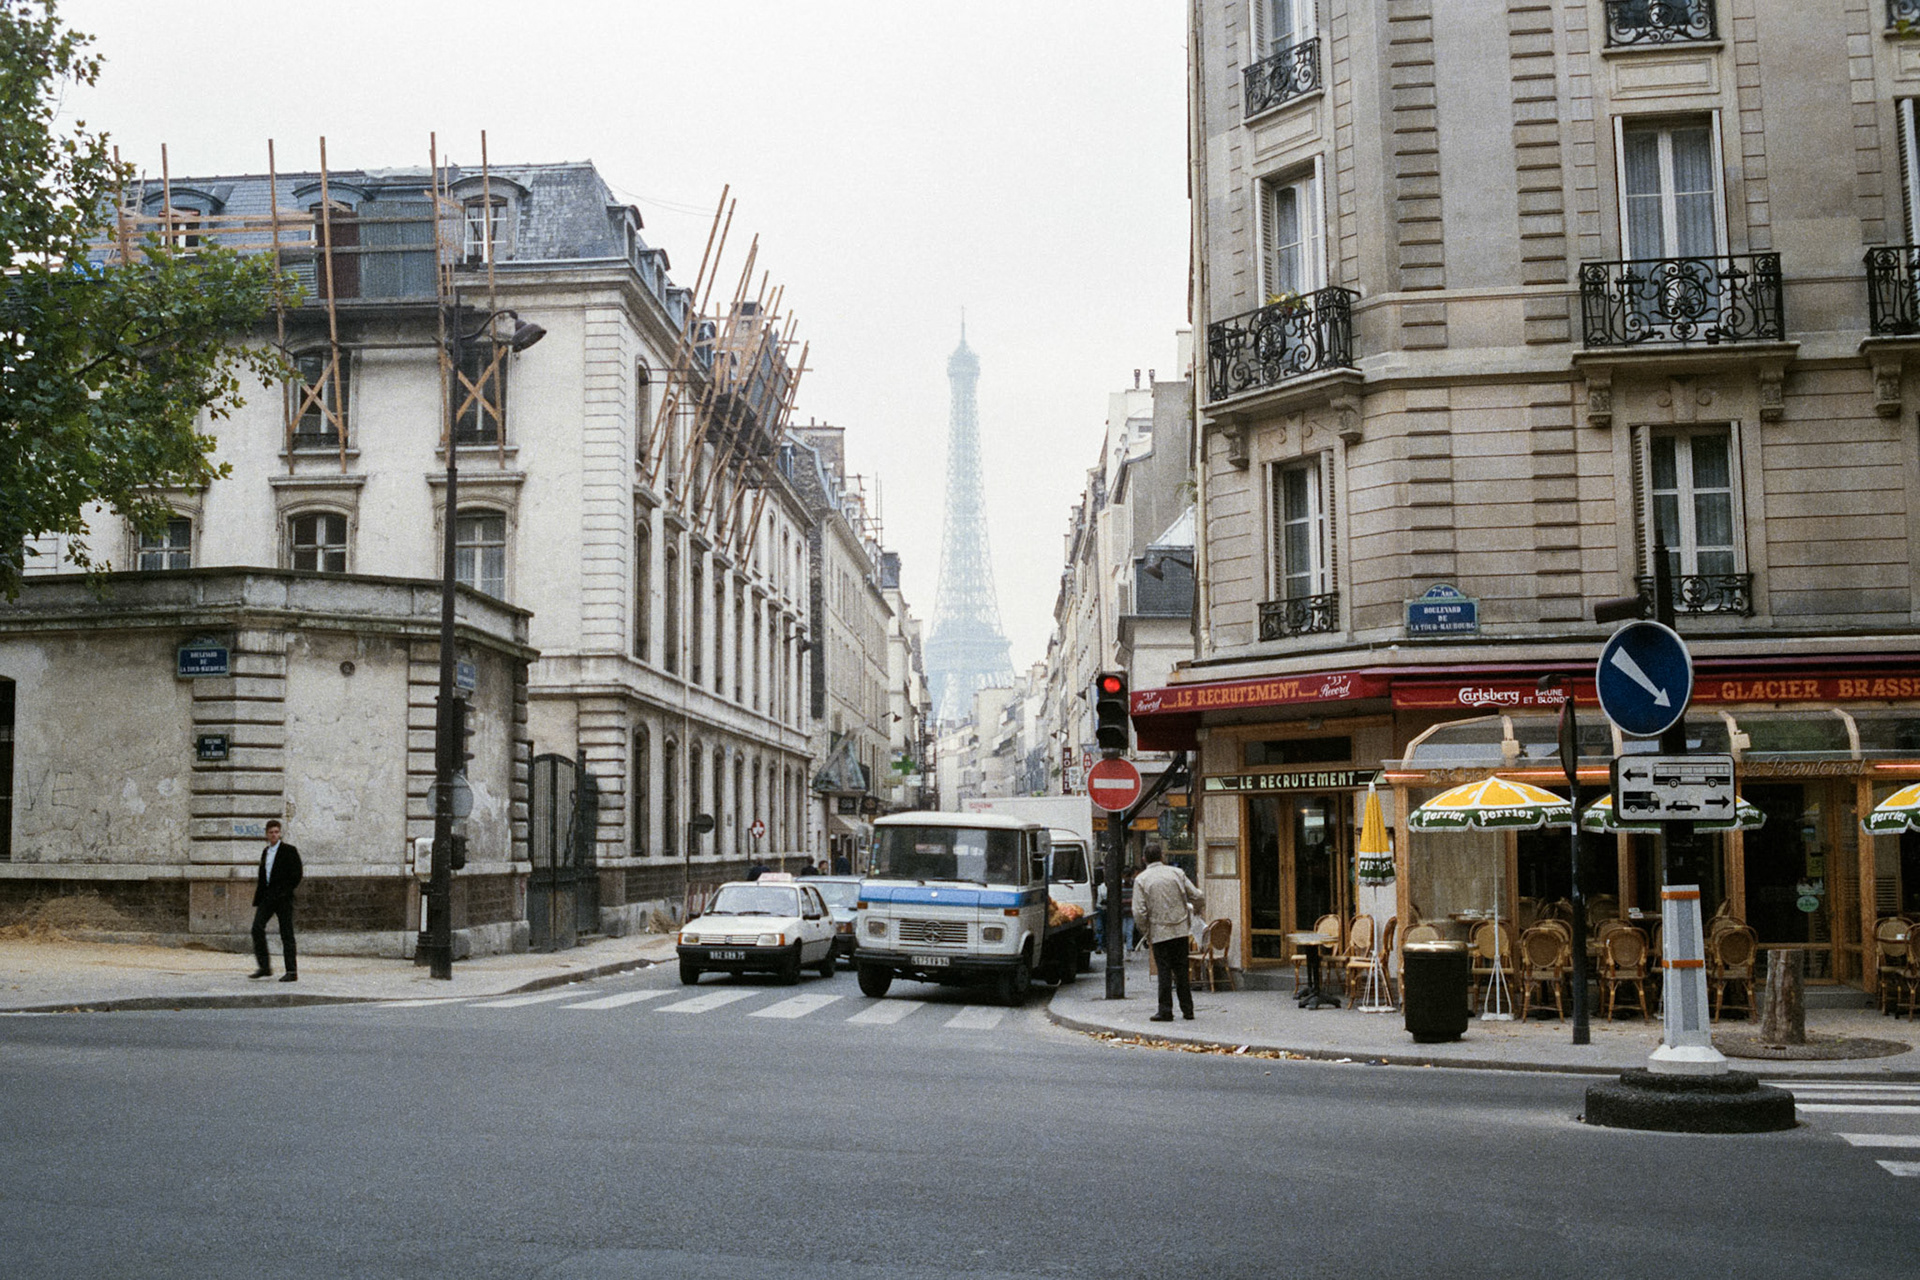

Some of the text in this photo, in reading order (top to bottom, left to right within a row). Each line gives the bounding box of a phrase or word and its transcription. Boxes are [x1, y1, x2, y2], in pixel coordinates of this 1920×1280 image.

[1423, 606, 1462, 615] BOULEVARD
[1177, 681, 1300, 707] LE RECRUTEMENT
[1319, 680, 1352, 698] Record
[1458, 687, 1520, 707] Carlsberg
[1722, 680, 1821, 699] GLACIER
[1537, 696, 1570, 704] BLOND
[1239, 772, 1355, 790] LE RECRUTEMENT
